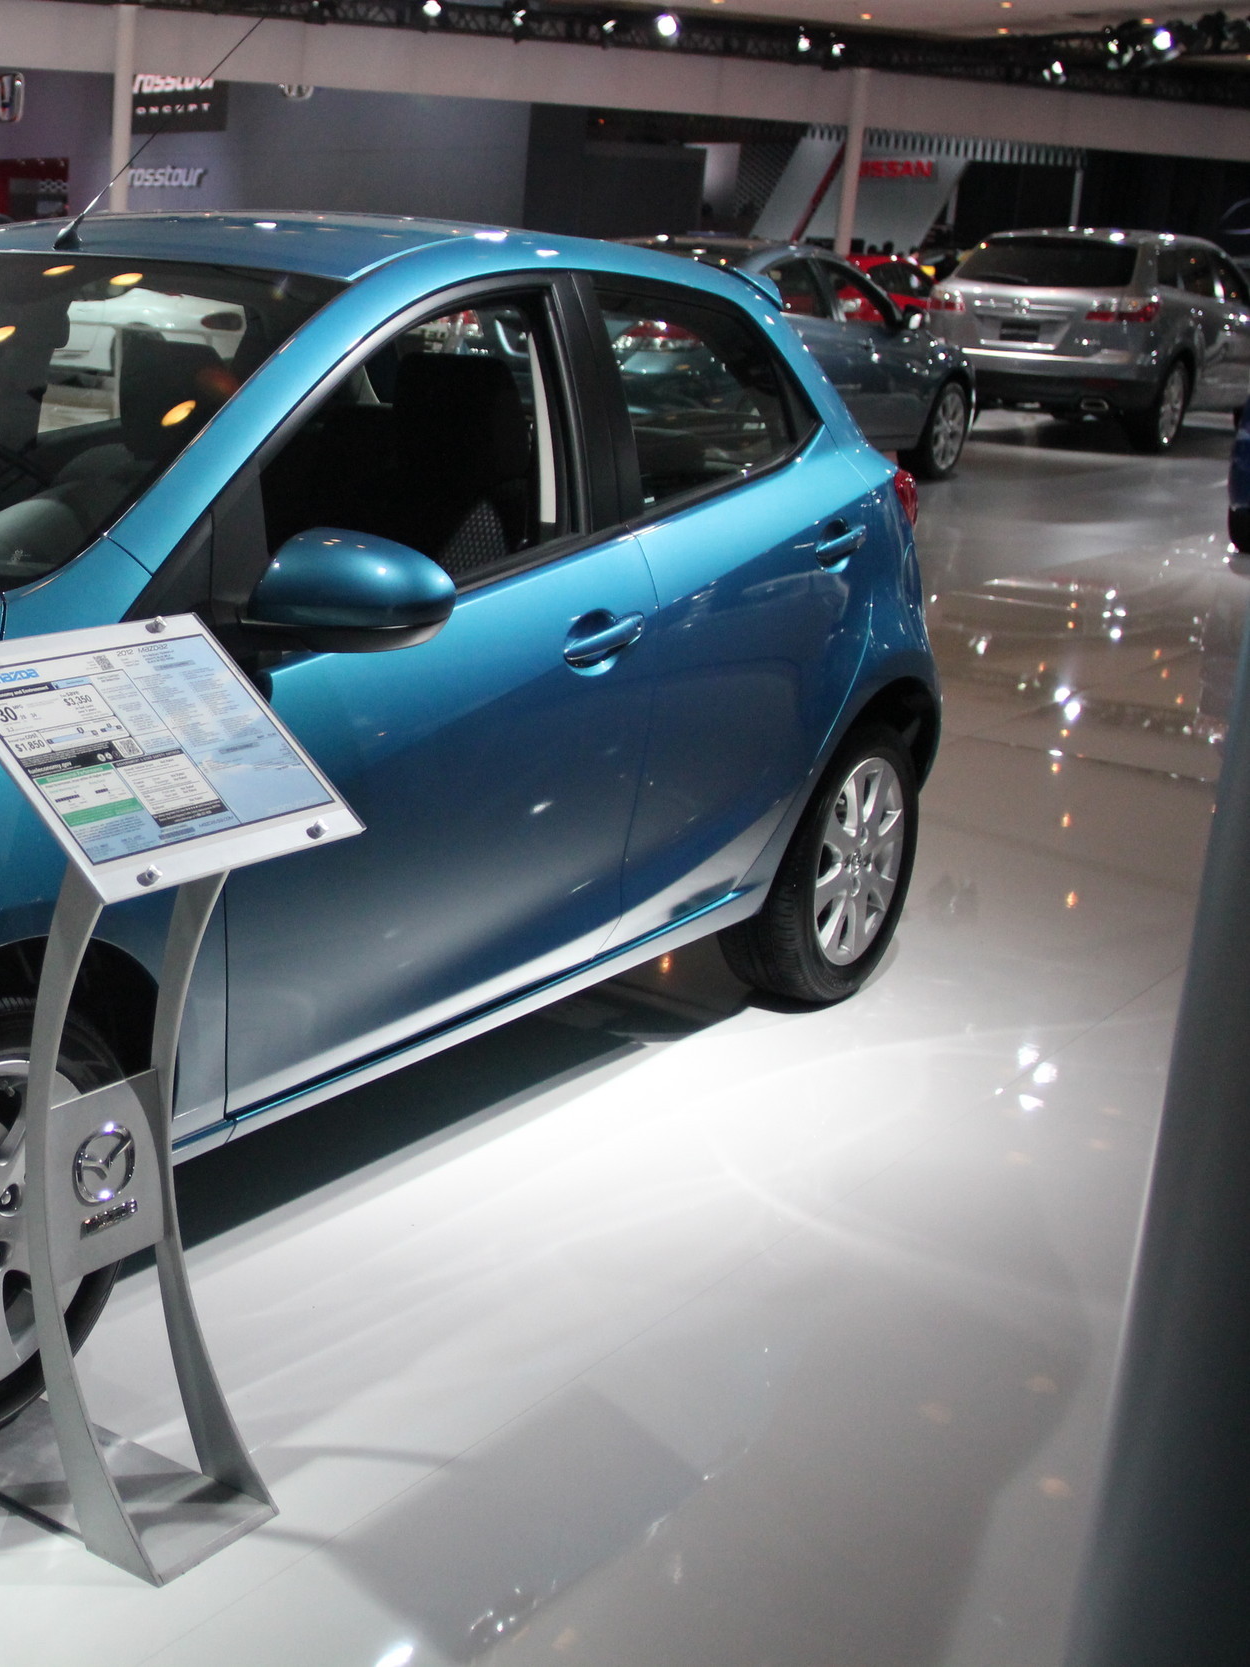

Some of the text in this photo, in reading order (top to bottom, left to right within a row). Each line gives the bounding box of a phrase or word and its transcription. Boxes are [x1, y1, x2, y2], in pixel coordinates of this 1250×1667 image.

[116, 649, 133, 657] 2012
[23, 685, 49, 694] Environment
[64, 695, 92, 706] $3,350
[15, 740, 45, 752] $1,850
